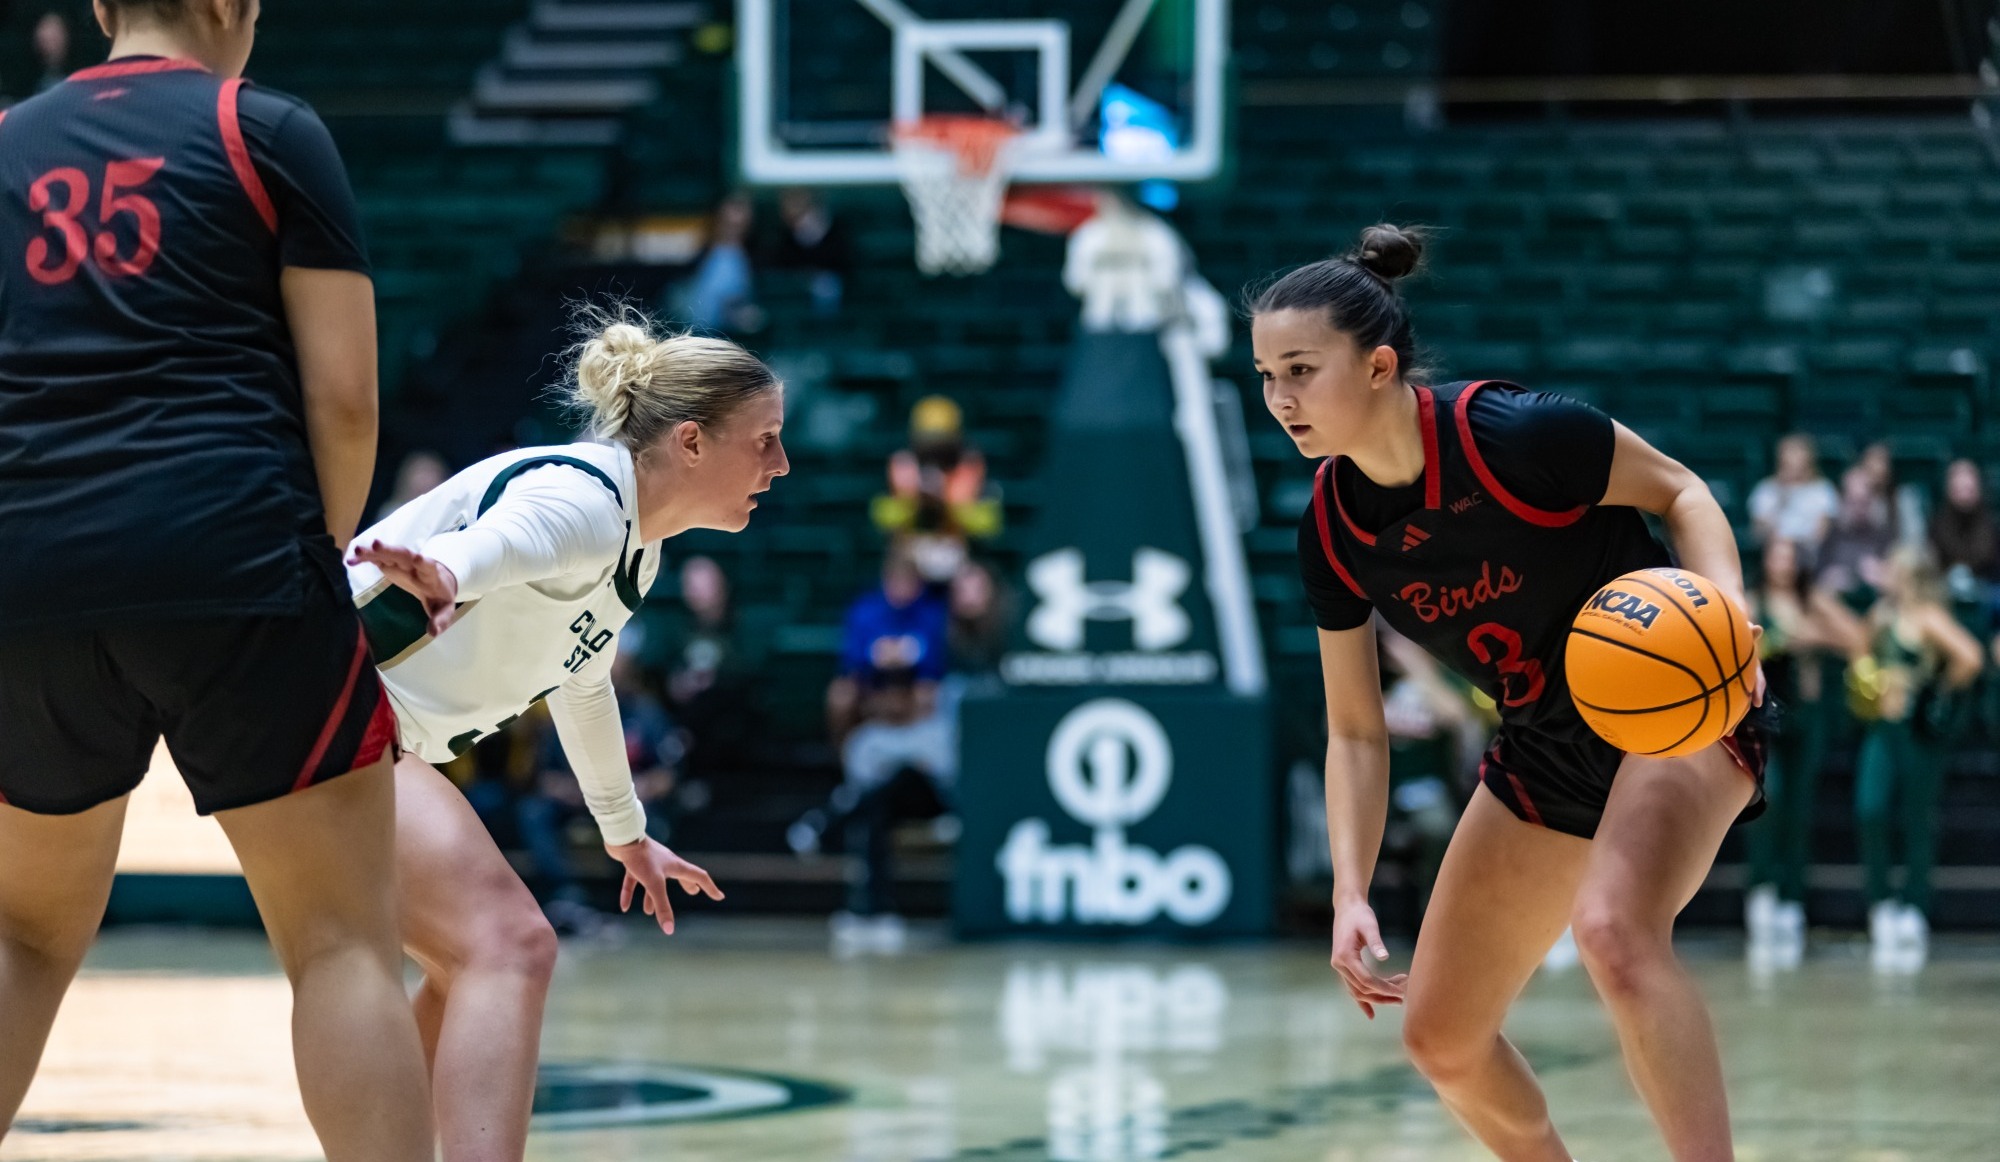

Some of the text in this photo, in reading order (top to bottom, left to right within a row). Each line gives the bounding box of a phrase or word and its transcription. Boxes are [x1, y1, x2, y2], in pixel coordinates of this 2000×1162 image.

[26, 157, 165, 285] 35
[1449, 492, 1483, 515] WAC
[1585, 588, 1662, 630] NCAA
[563, 644, 593, 675] ST
[1467, 622, 1546, 708] 3
